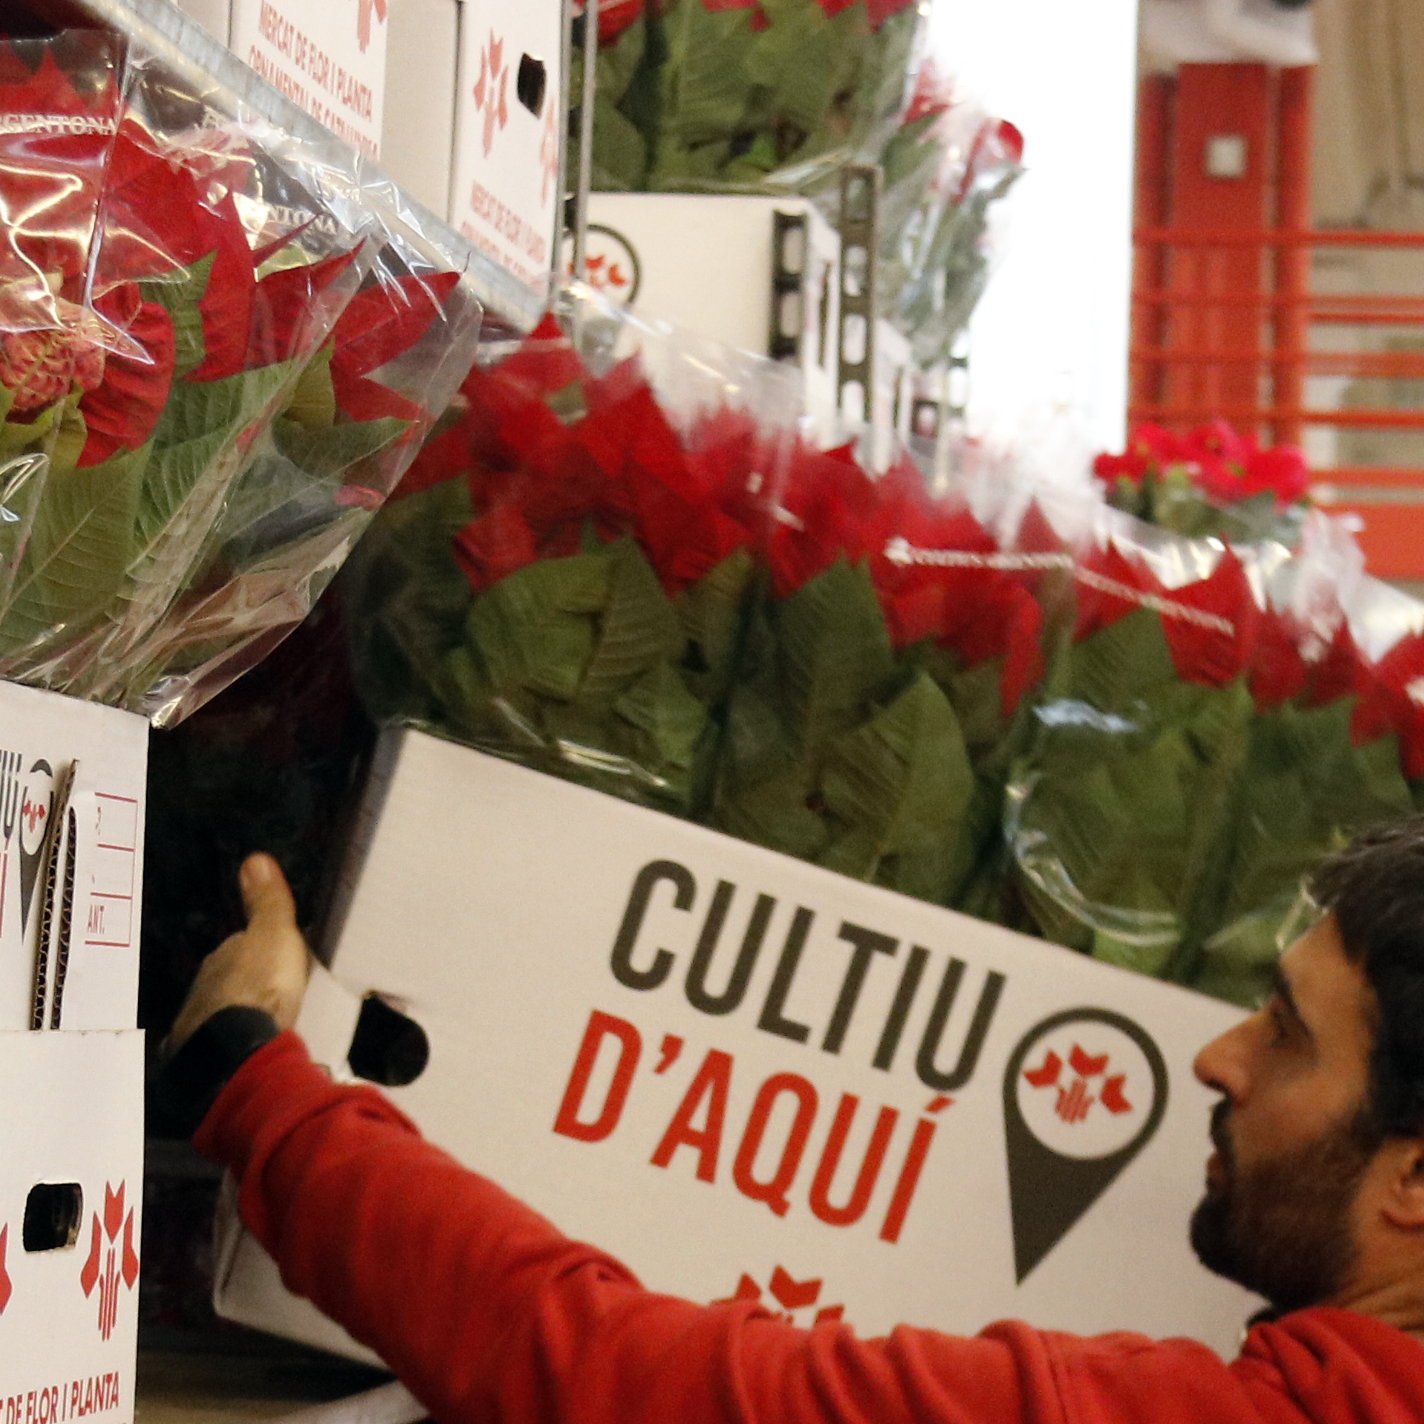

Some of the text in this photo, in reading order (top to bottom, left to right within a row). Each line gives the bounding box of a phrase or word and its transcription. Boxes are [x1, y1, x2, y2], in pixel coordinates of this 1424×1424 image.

[610, 859, 1007, 1092] CULTIU
[552, 1008, 956, 1245] D'AQUÍ
[61, 1383, 68, 1422] I
[70, 1371, 120, 1420] PLANTA
